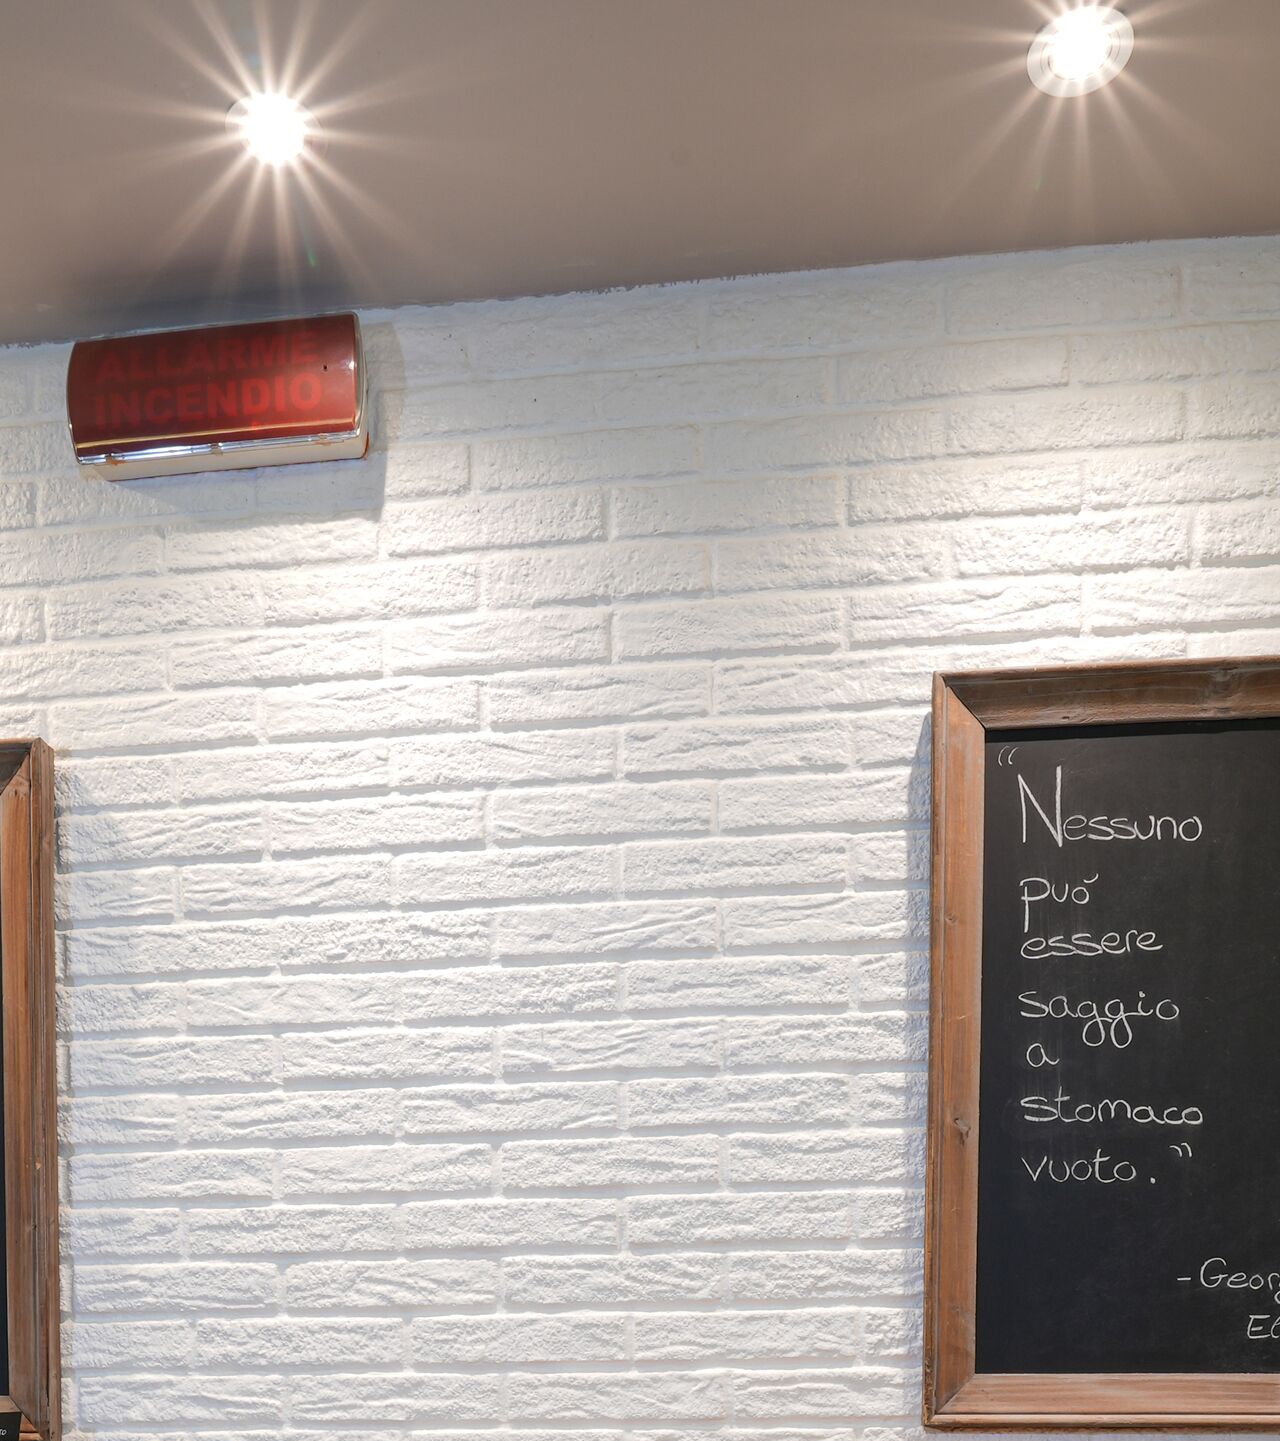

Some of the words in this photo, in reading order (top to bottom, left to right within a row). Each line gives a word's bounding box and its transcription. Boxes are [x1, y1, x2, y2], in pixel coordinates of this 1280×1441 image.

[95, 331, 317, 384] ALLARME
[95, 373, 321, 432] INCENDIO
[1020, 929, 1163, 959] essere
[1018, 991, 1180, 1048] saggio
[1026, 1043, 1060, 1067] a
[1020, 1086, 1203, 1125] stomaco
